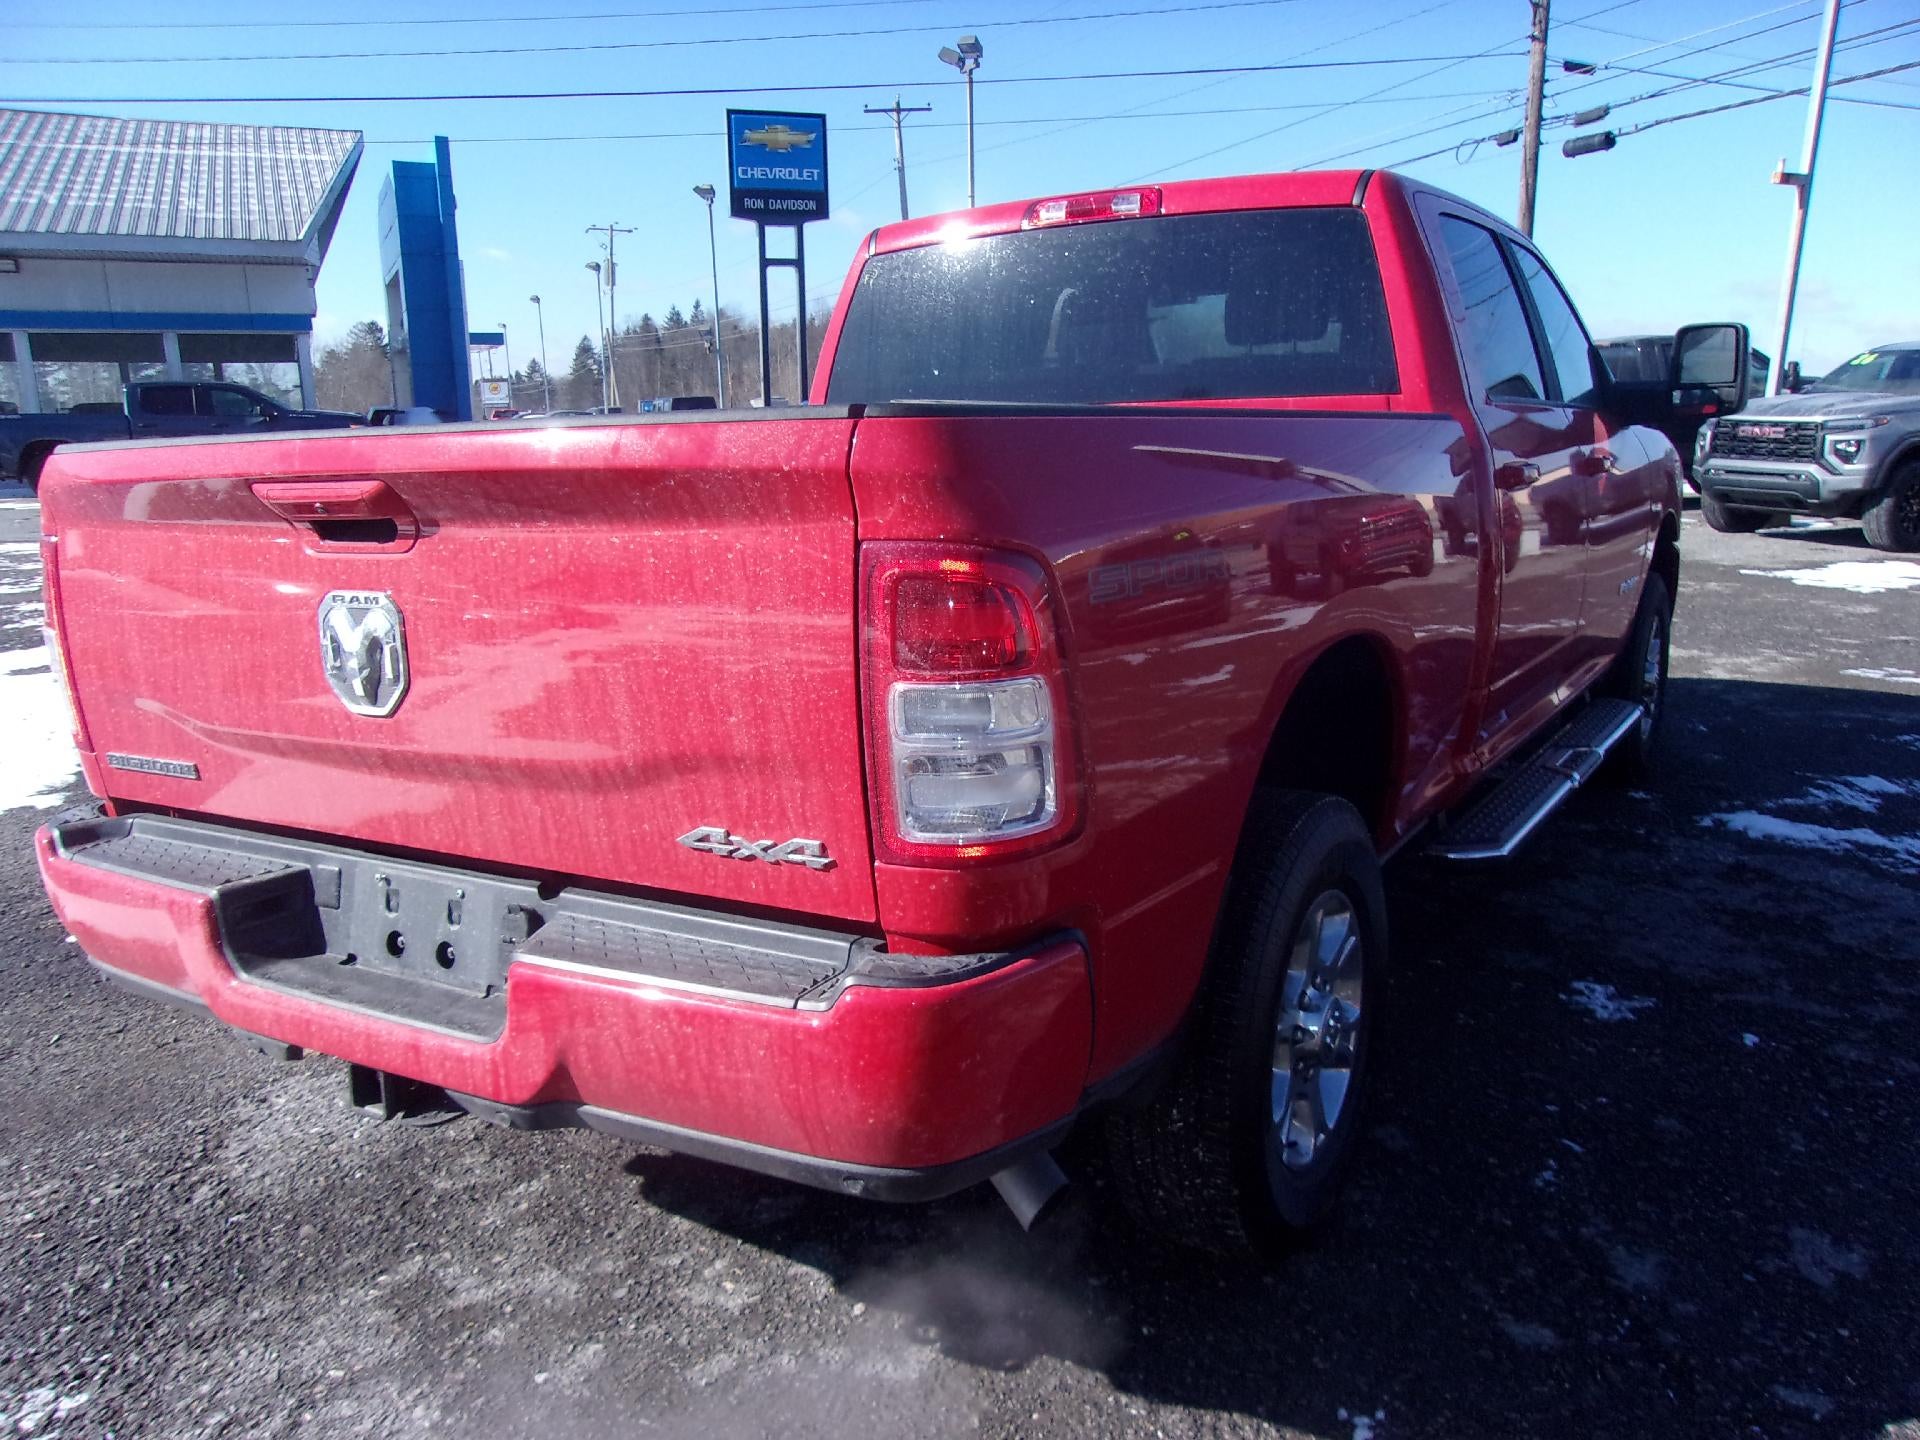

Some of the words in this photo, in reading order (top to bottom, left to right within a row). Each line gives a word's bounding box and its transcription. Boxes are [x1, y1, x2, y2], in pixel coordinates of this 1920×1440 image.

[738, 166, 820, 181] CHEVROLET
[744, 198, 764, 209] RON
[769, 199, 817, 211] DAVIDSON
[332, 594, 380, 606] RAM
